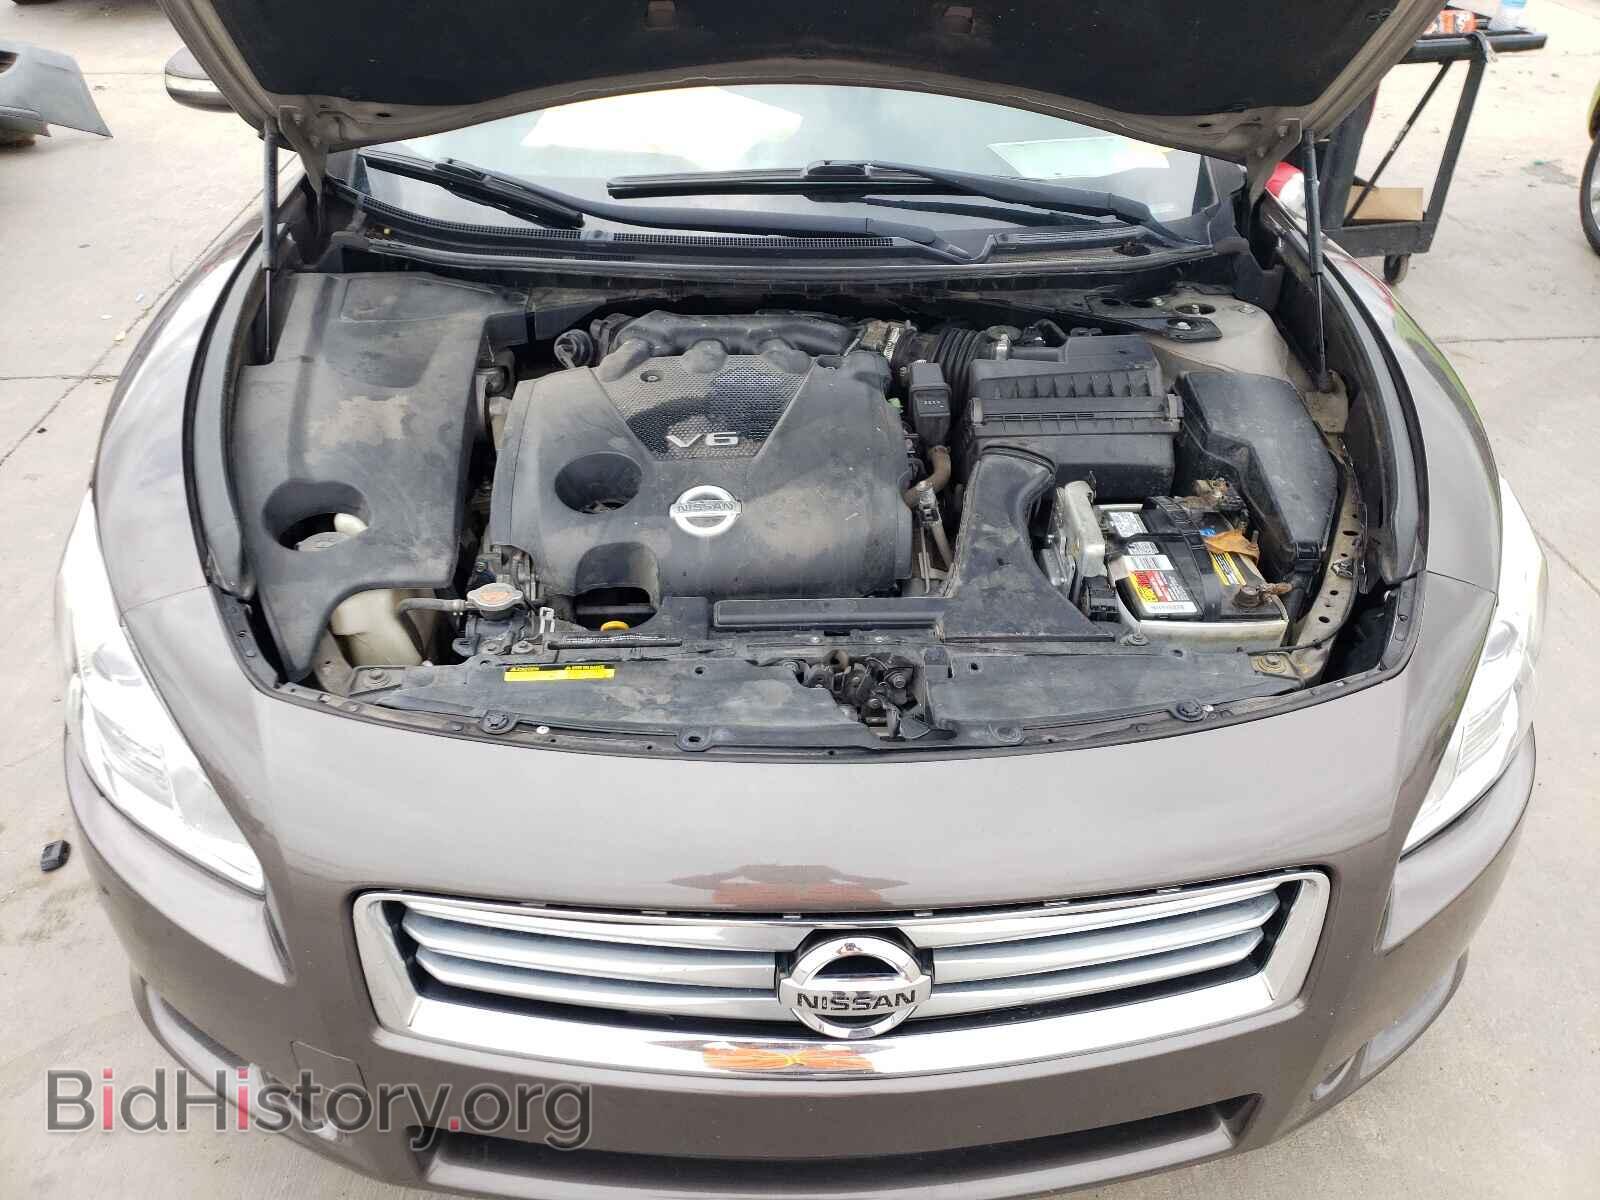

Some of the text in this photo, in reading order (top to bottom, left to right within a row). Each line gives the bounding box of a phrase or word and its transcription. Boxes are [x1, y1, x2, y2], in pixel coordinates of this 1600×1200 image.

[666, 432, 739, 448] V6
[677, 502, 734, 513] NISSAN
[797, 990, 916, 1011] NISSAN
